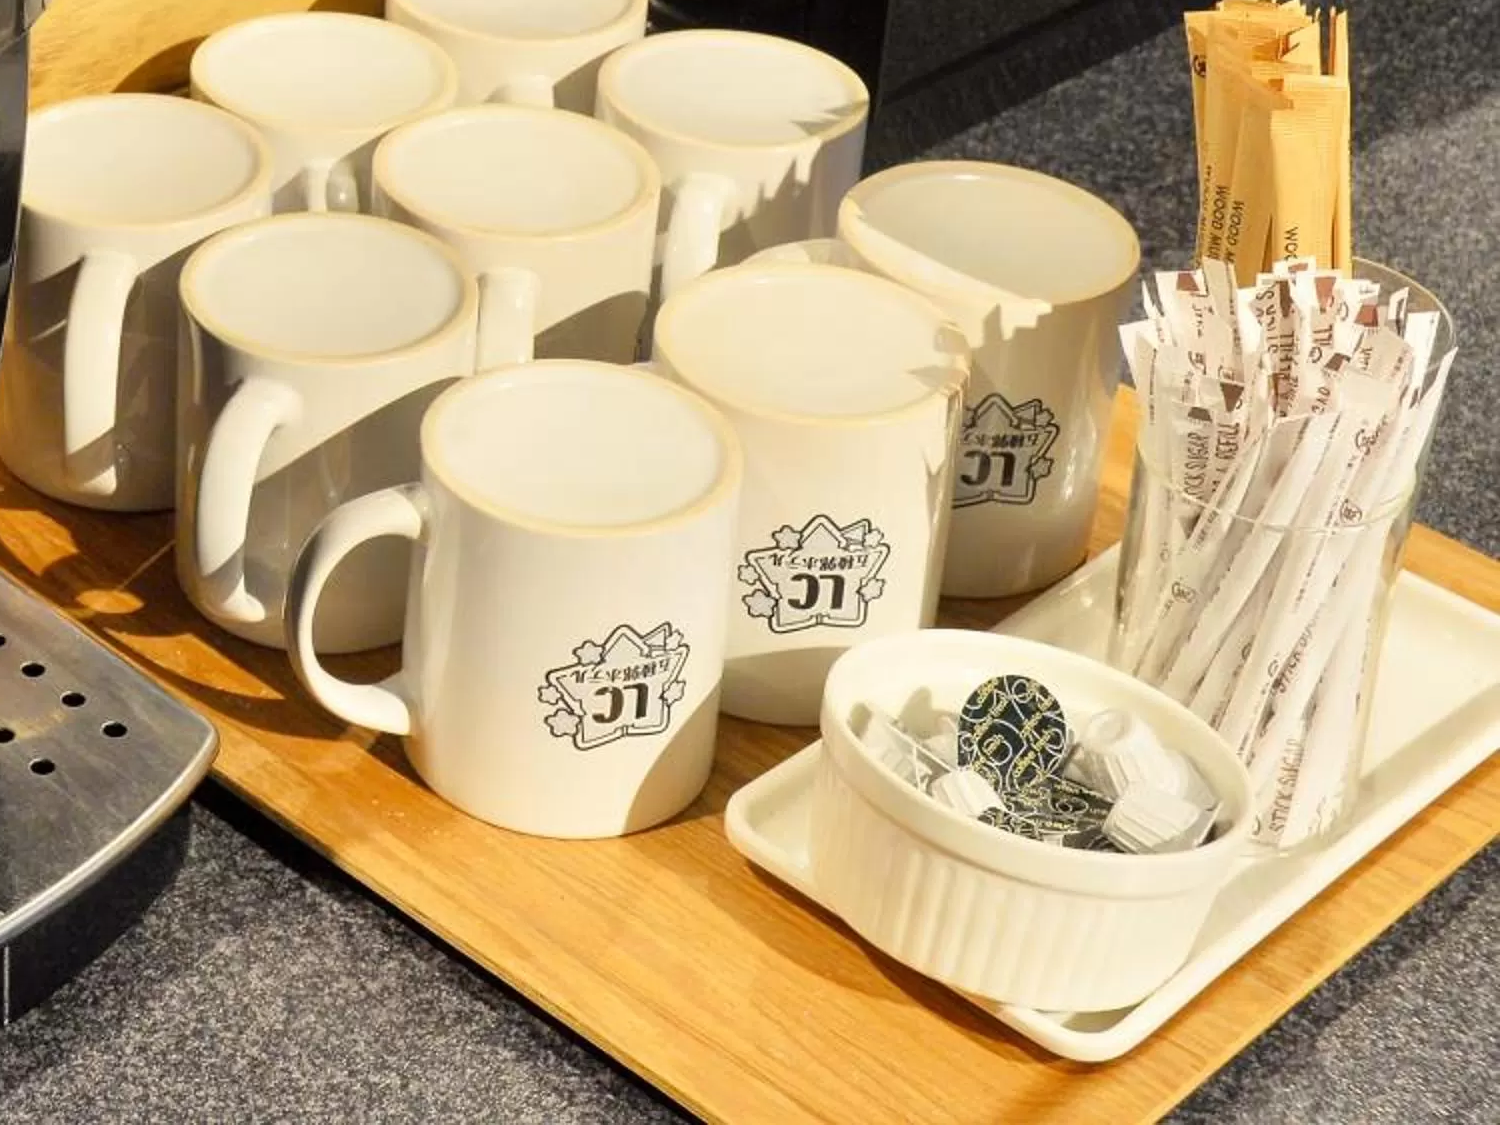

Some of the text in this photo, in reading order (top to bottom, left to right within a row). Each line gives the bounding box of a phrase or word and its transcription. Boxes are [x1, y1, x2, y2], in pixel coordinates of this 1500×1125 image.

[959, 449, 1018, 488] LC
[788, 573, 846, 611] LC
[592, 683, 649, 725] LC
